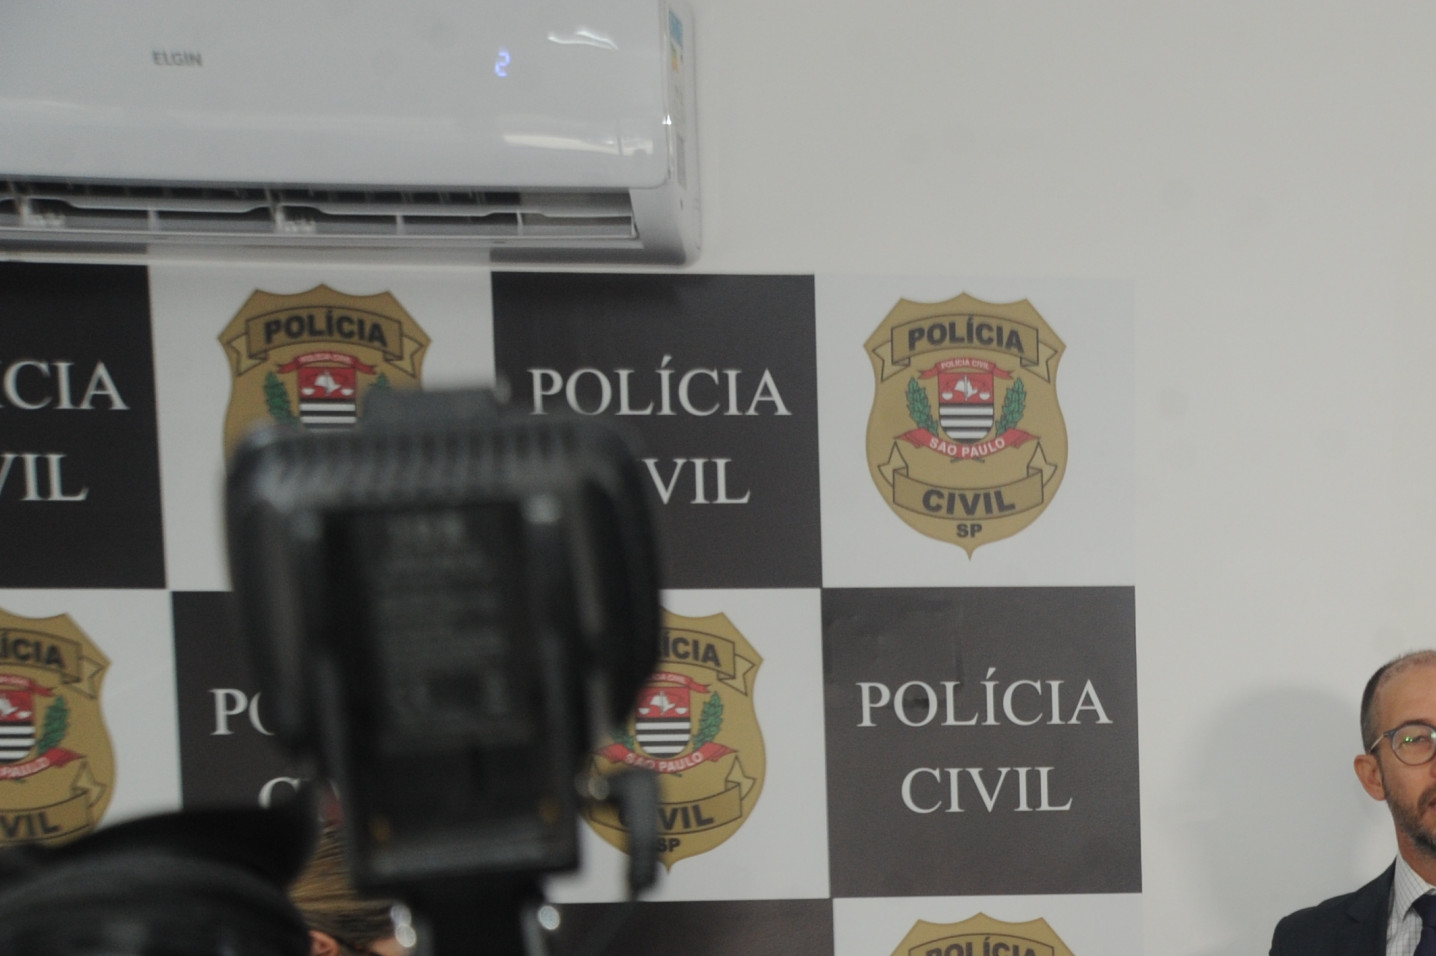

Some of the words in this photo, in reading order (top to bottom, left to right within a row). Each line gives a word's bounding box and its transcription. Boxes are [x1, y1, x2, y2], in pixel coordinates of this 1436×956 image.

[152, 49, 203, 67] ELGIN
[264, 309, 387, 348] POLÍCIA
[908, 312, 1025, 354] POLÍCIA
[0, 360, 131, 411] CIA
[527, 354, 792, 417] POLÍCIA
[961, 437, 1006, 457] PAULO
[641, 457, 751, 505] VIL
[922, 488, 1016, 516] CIVIL
[956, 523, 983, 538] SP
[0, 629, 66, 670] ÍCIA
[662, 630, 721, 668] ÍCIA
[856, 667, 1114, 727] POLÍCIA
[658, 751, 704, 772] PAULO
[901, 766, 1073, 814] CIVIL
[656, 804, 715, 831] VIL
